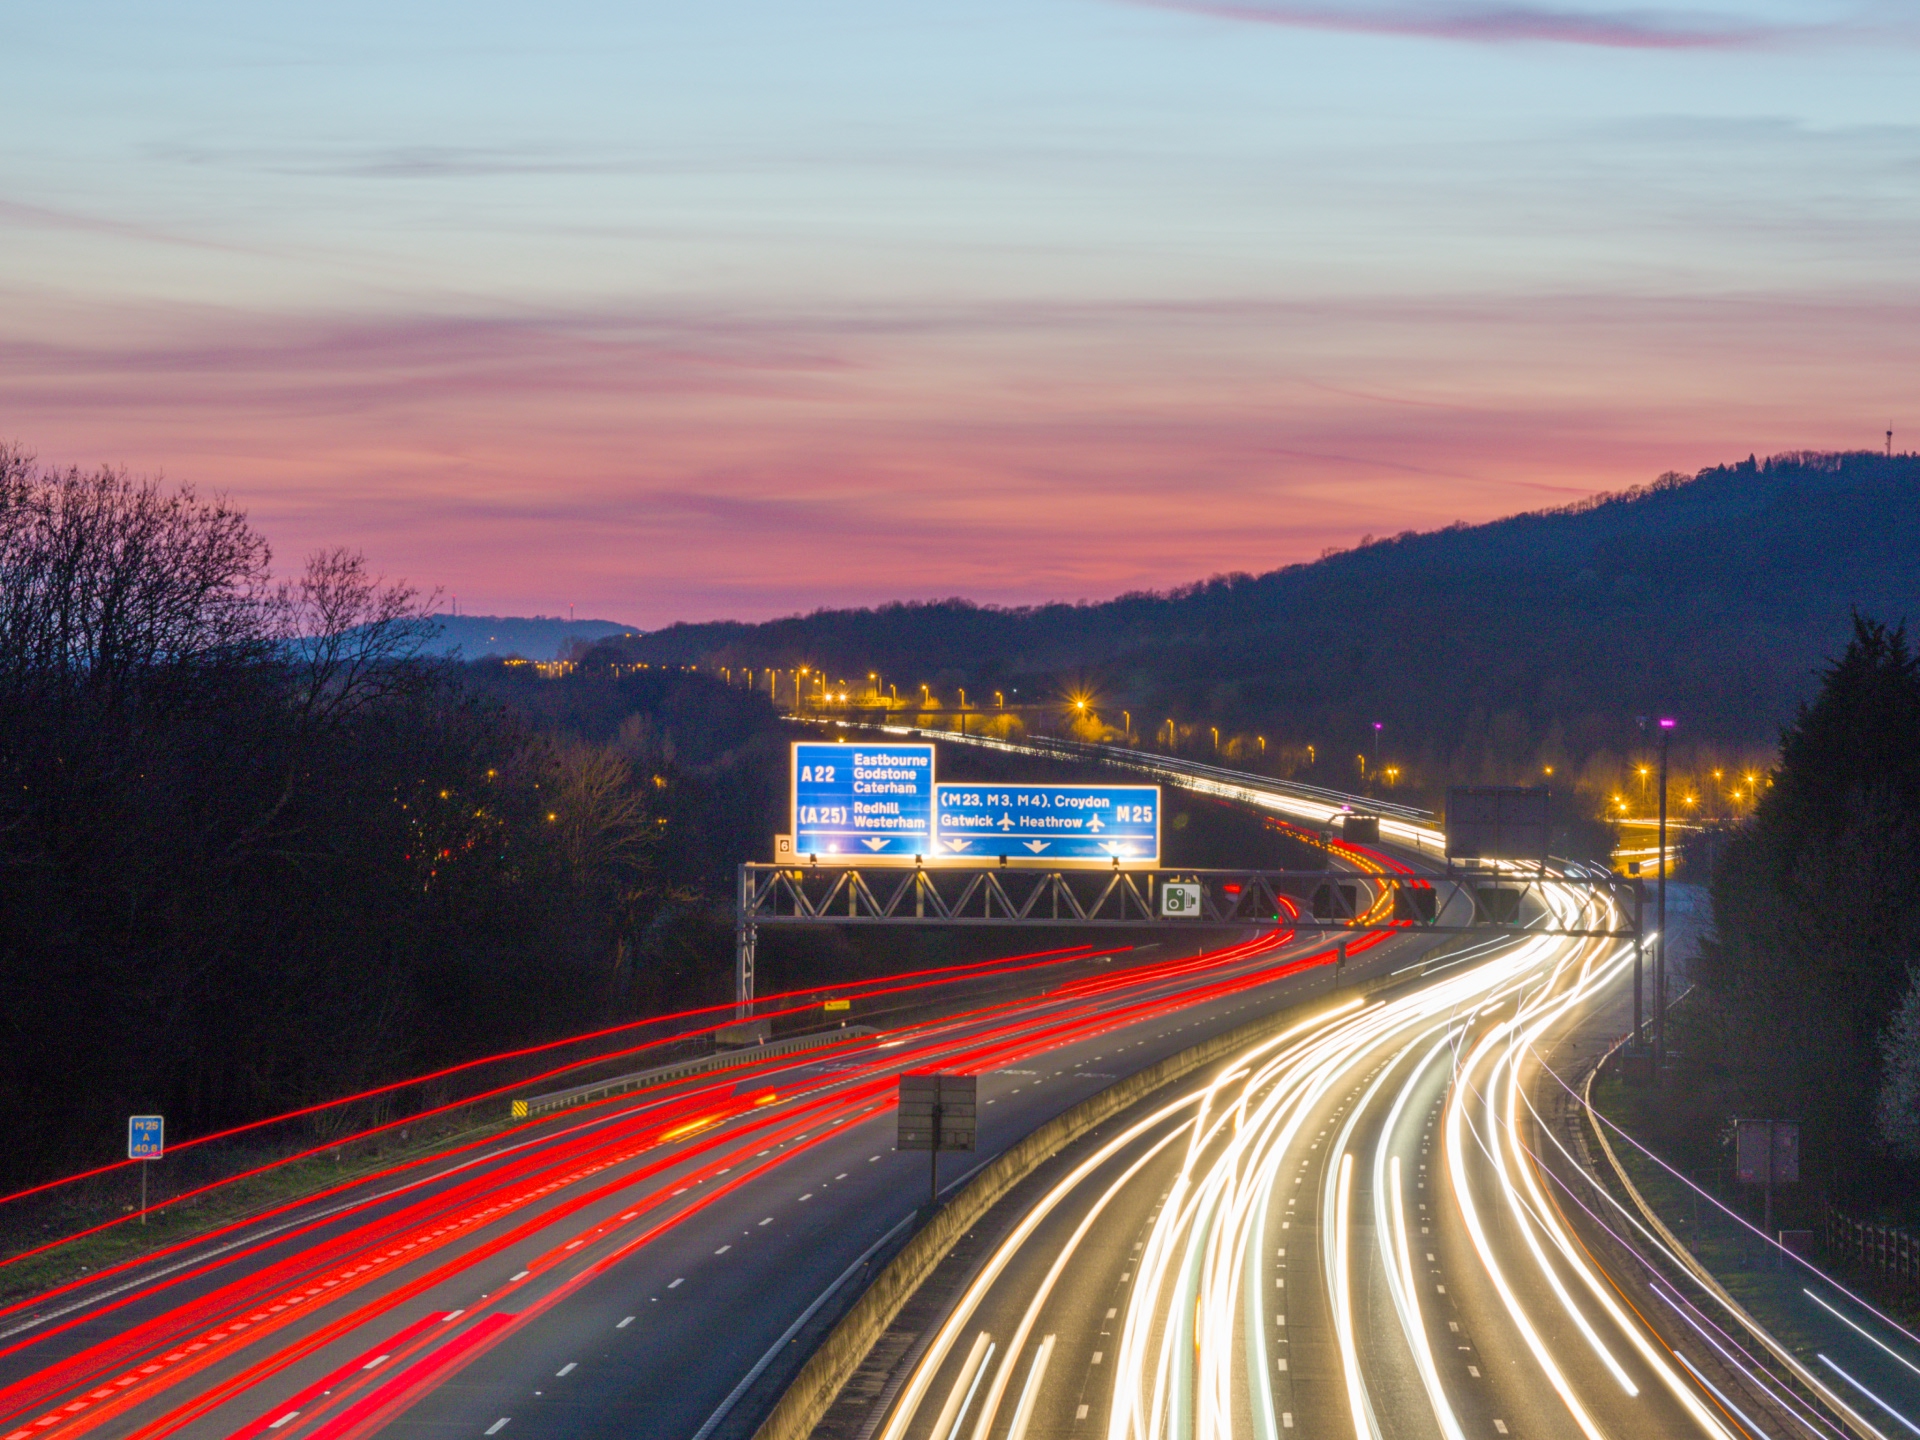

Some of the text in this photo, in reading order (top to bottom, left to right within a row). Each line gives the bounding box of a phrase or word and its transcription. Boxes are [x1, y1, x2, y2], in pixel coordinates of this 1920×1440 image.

[854, 753, 928, 766] Eastbourne
[801, 766, 835, 782] A22
[853, 767, 917, 780] Godstone
[853, 781, 917, 794] Caterham
[854, 802, 899, 814] Redhill
[1054, 795, 1110, 809] Croydon
[800, 806, 847, 825] (A25)
[1117, 806, 1153, 822] M25
[853, 816, 925, 828] Westerham
[941, 814, 1082, 828] Gatwick Heathrow
[781, 841, 789, 851] 6
[135, 1121, 158, 1130] M25
[142, 1133, 150, 1141] A
